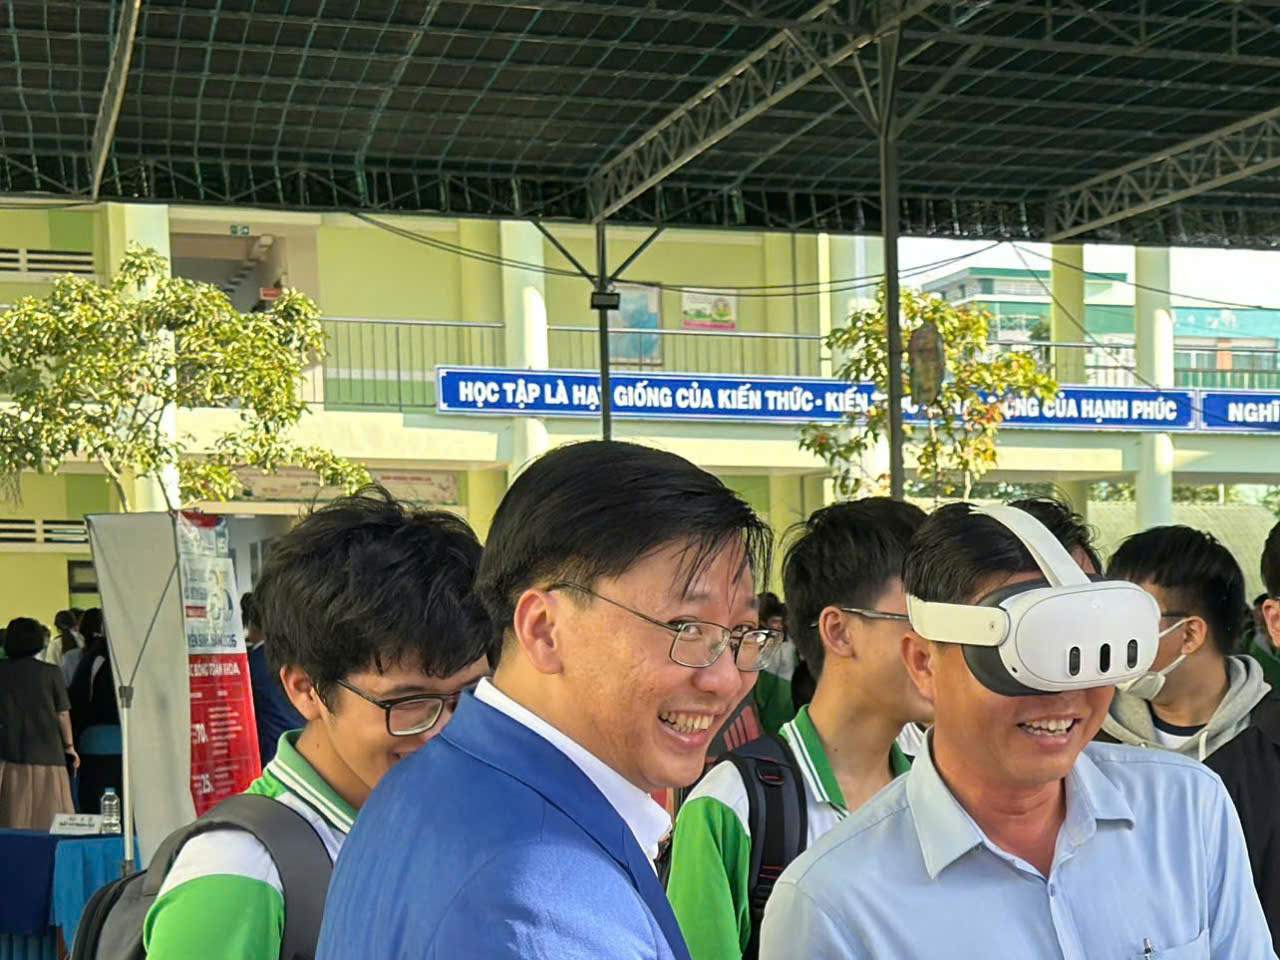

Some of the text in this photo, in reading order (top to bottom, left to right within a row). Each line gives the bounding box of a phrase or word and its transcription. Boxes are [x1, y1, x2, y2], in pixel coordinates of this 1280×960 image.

[459, 380, 500, 408] HỌC
[502, 378, 541, 409] TẬP
[544, 379, 569, 405] LÀ
[572, 384, 602, 410] HẠ
[614, 380, 673, 408] GIỐNG
[675, 382, 714, 409] CỦA
[717, 384, 762, 410] KIẾN
[764, 386, 814, 411] THỨC
[825, 386, 869, 413] KIẾN
[1042, 391, 1079, 418] CỦA
[1081, 398, 1129, 424] HẠNH
[1131, 396, 1177, 421] PHÚC
[1228, 400, 1280, 423] NGHĨ
